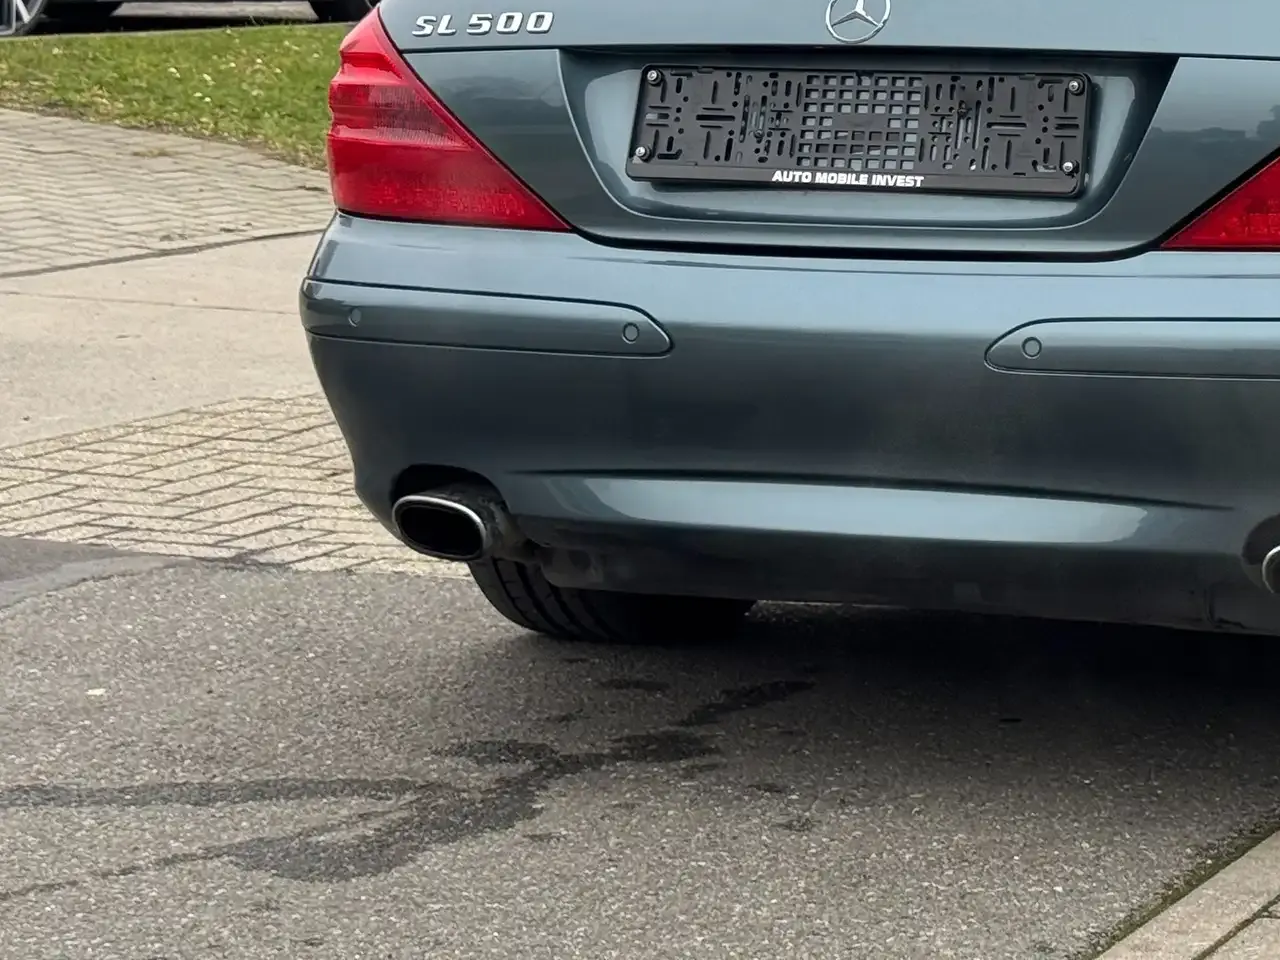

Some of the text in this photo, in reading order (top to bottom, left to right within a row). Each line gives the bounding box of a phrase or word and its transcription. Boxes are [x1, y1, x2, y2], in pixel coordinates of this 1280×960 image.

[412, 11, 554, 37] SL 500
[771, 170, 925, 188] AUTO MOBILE INVEST
